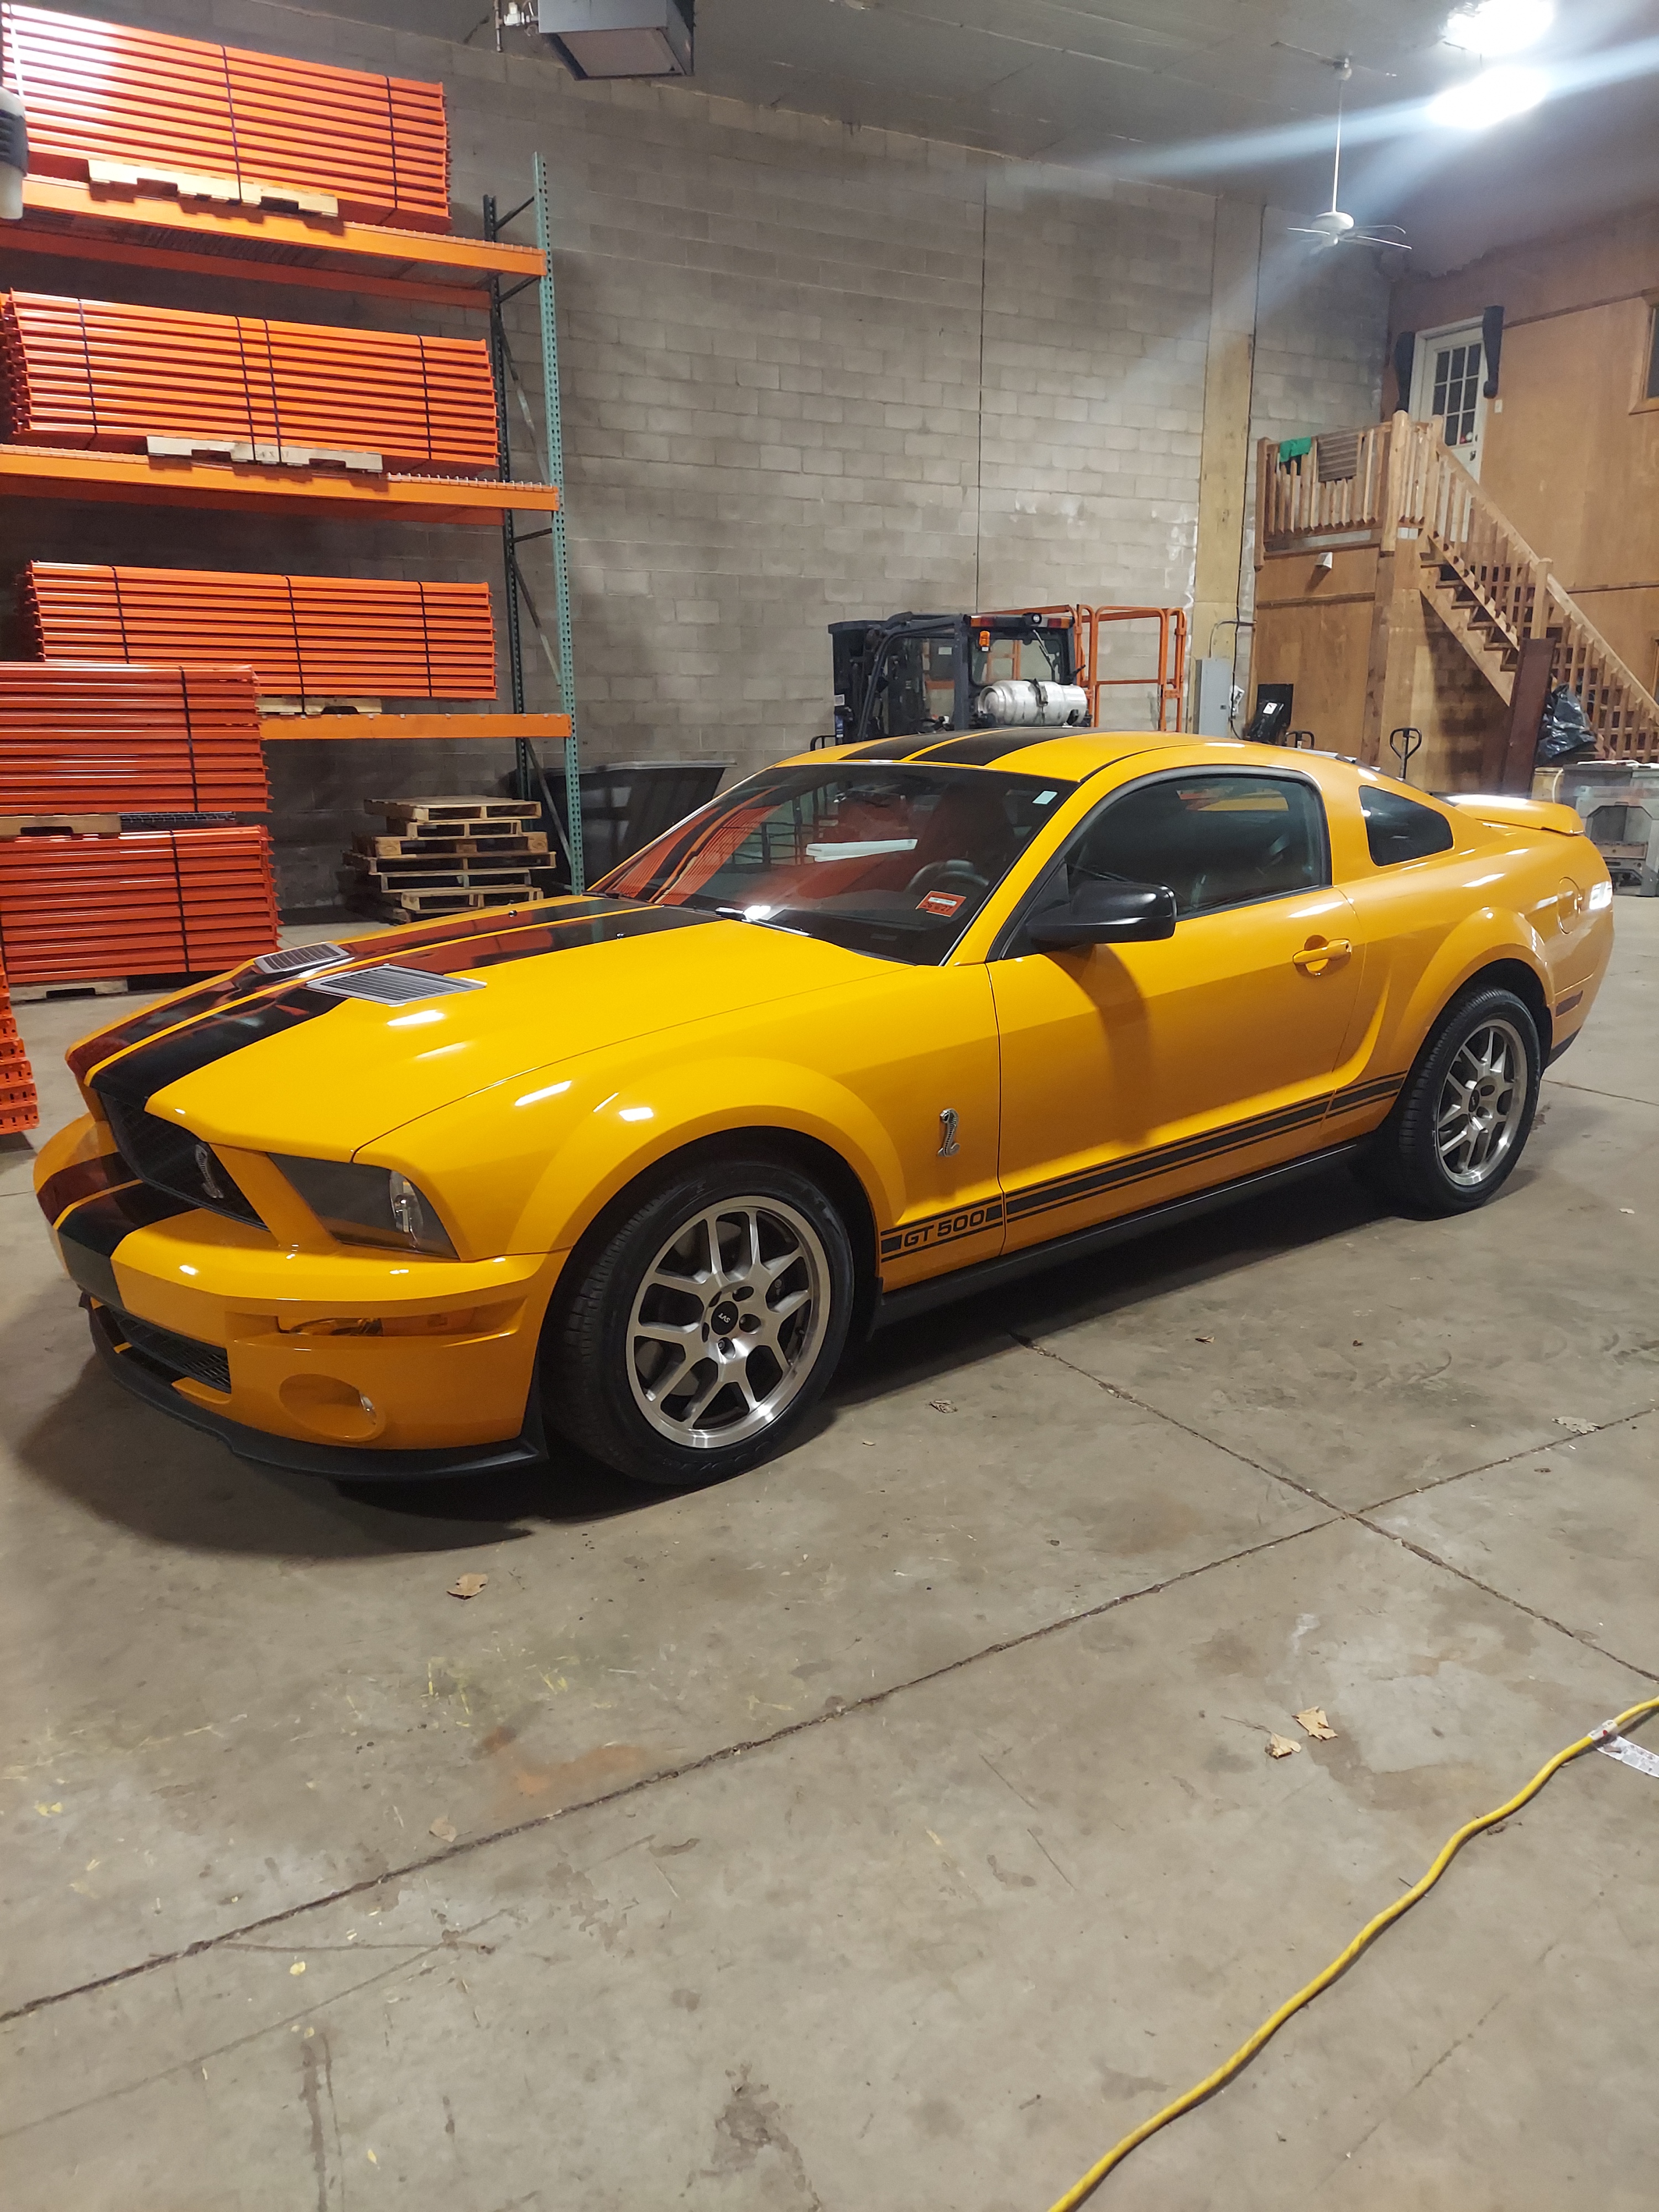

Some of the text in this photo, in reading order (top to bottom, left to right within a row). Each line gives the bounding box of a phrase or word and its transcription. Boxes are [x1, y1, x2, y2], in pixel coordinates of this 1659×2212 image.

[904, 1209, 985, 1247] GT 500
[718, 1312, 731, 1323] SVT
